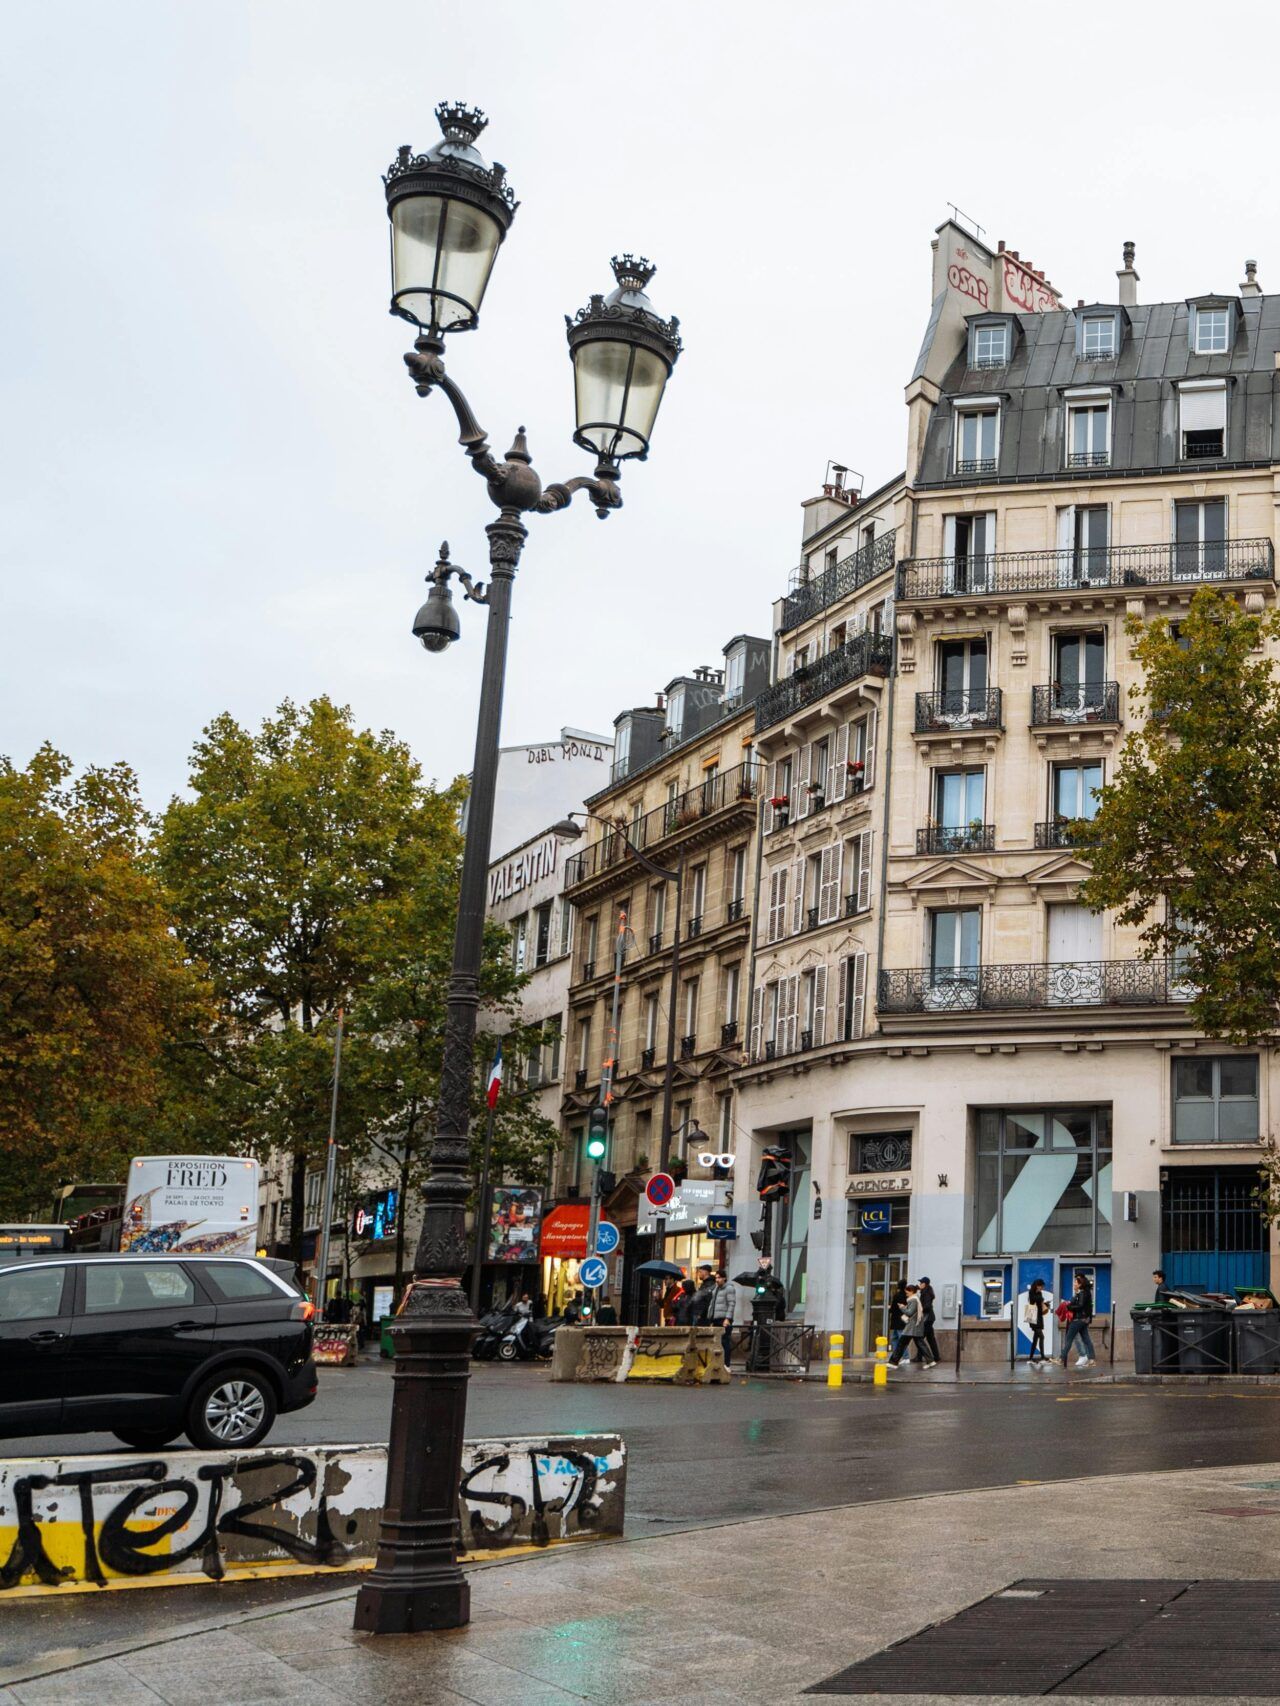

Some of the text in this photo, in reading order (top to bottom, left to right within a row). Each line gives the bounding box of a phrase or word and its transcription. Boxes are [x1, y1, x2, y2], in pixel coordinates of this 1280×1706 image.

[488, 837, 558, 907] VALENTIN
[168, 1162, 225, 1170] EXPOSITION
[166, 1170, 227, 1187] FRED
[864, 1211, 887, 1221] LCL
[709, 1220, 732, 1229] LCL
